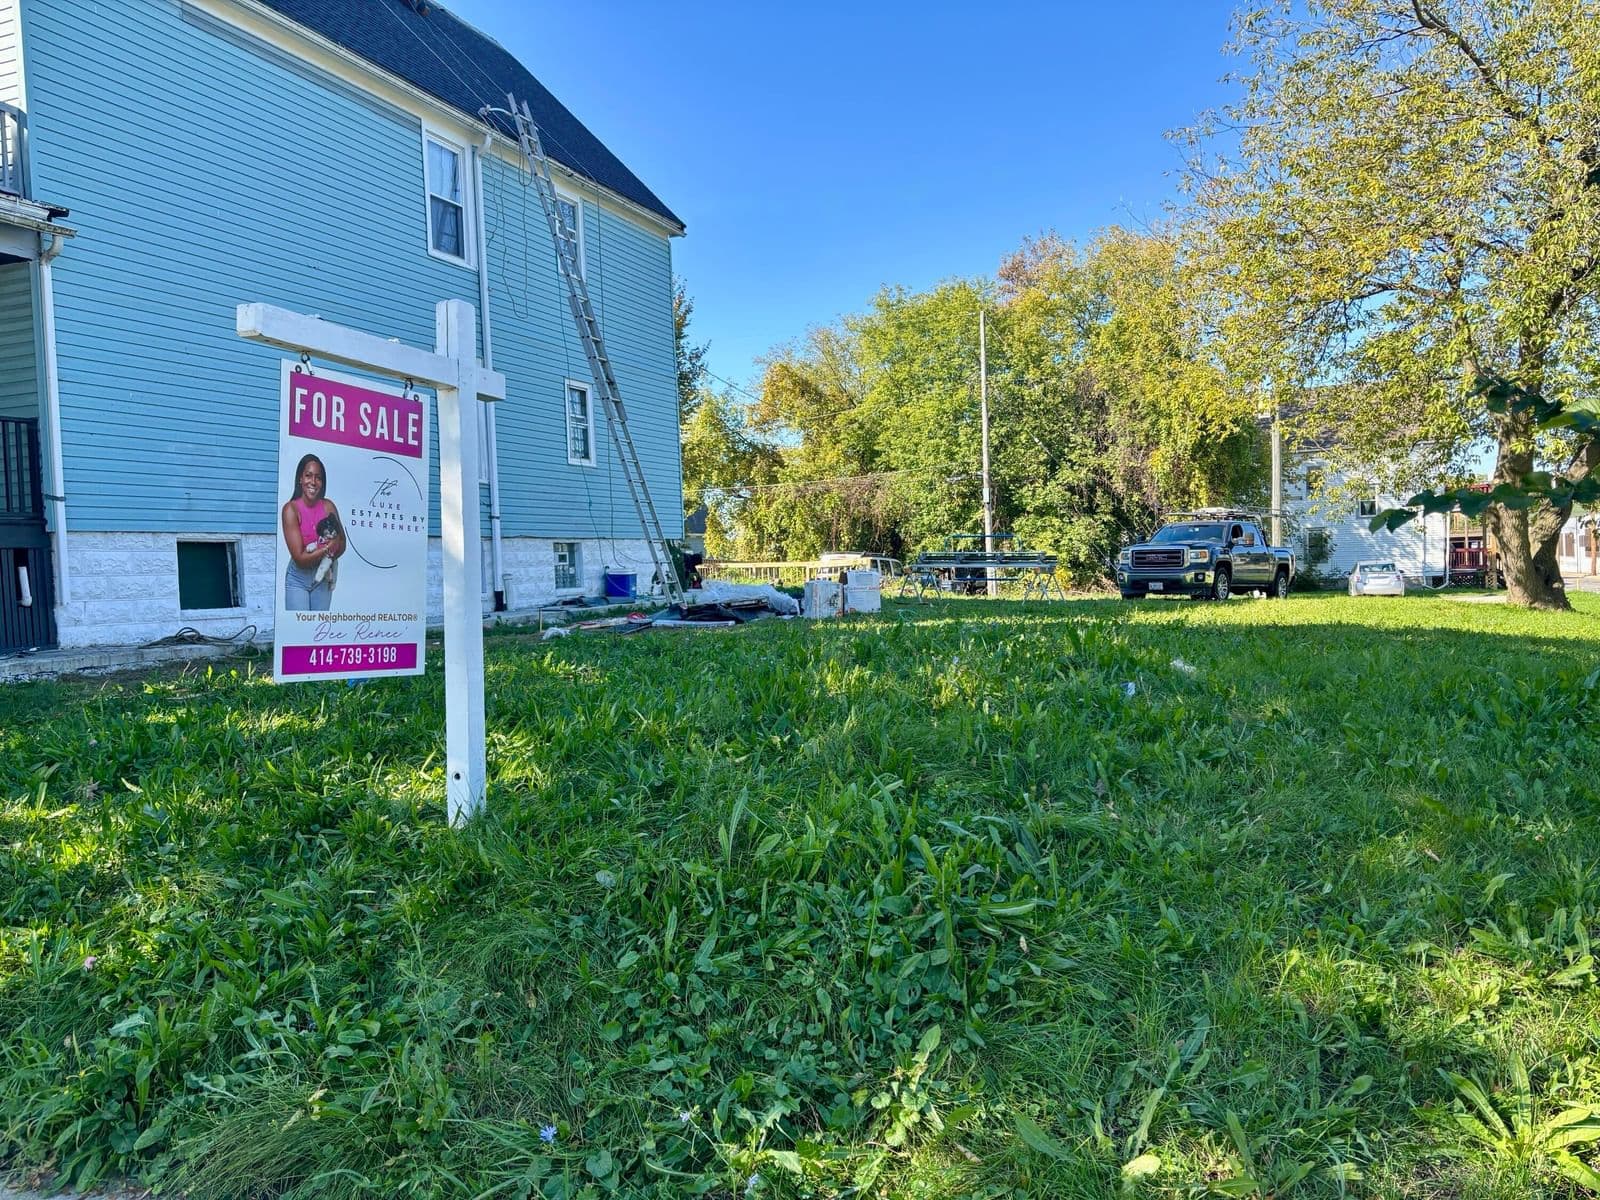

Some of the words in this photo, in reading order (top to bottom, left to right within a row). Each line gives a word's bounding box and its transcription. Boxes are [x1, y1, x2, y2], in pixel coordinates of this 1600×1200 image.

[294, 387, 345, 432] FOR
[359, 402, 419, 446] SALE
[371, 501, 401, 511] LUXE
[351, 508, 404, 521] ESTATES
[412, 515, 425, 523] BY
[351, 519, 374, 528] DEE
[295, 612, 316, 622] Your
[318, 612, 376, 623] Neighborhood
[313, 620, 347, 642] Dee
[309, 646, 397, 666] 414-739-3198
